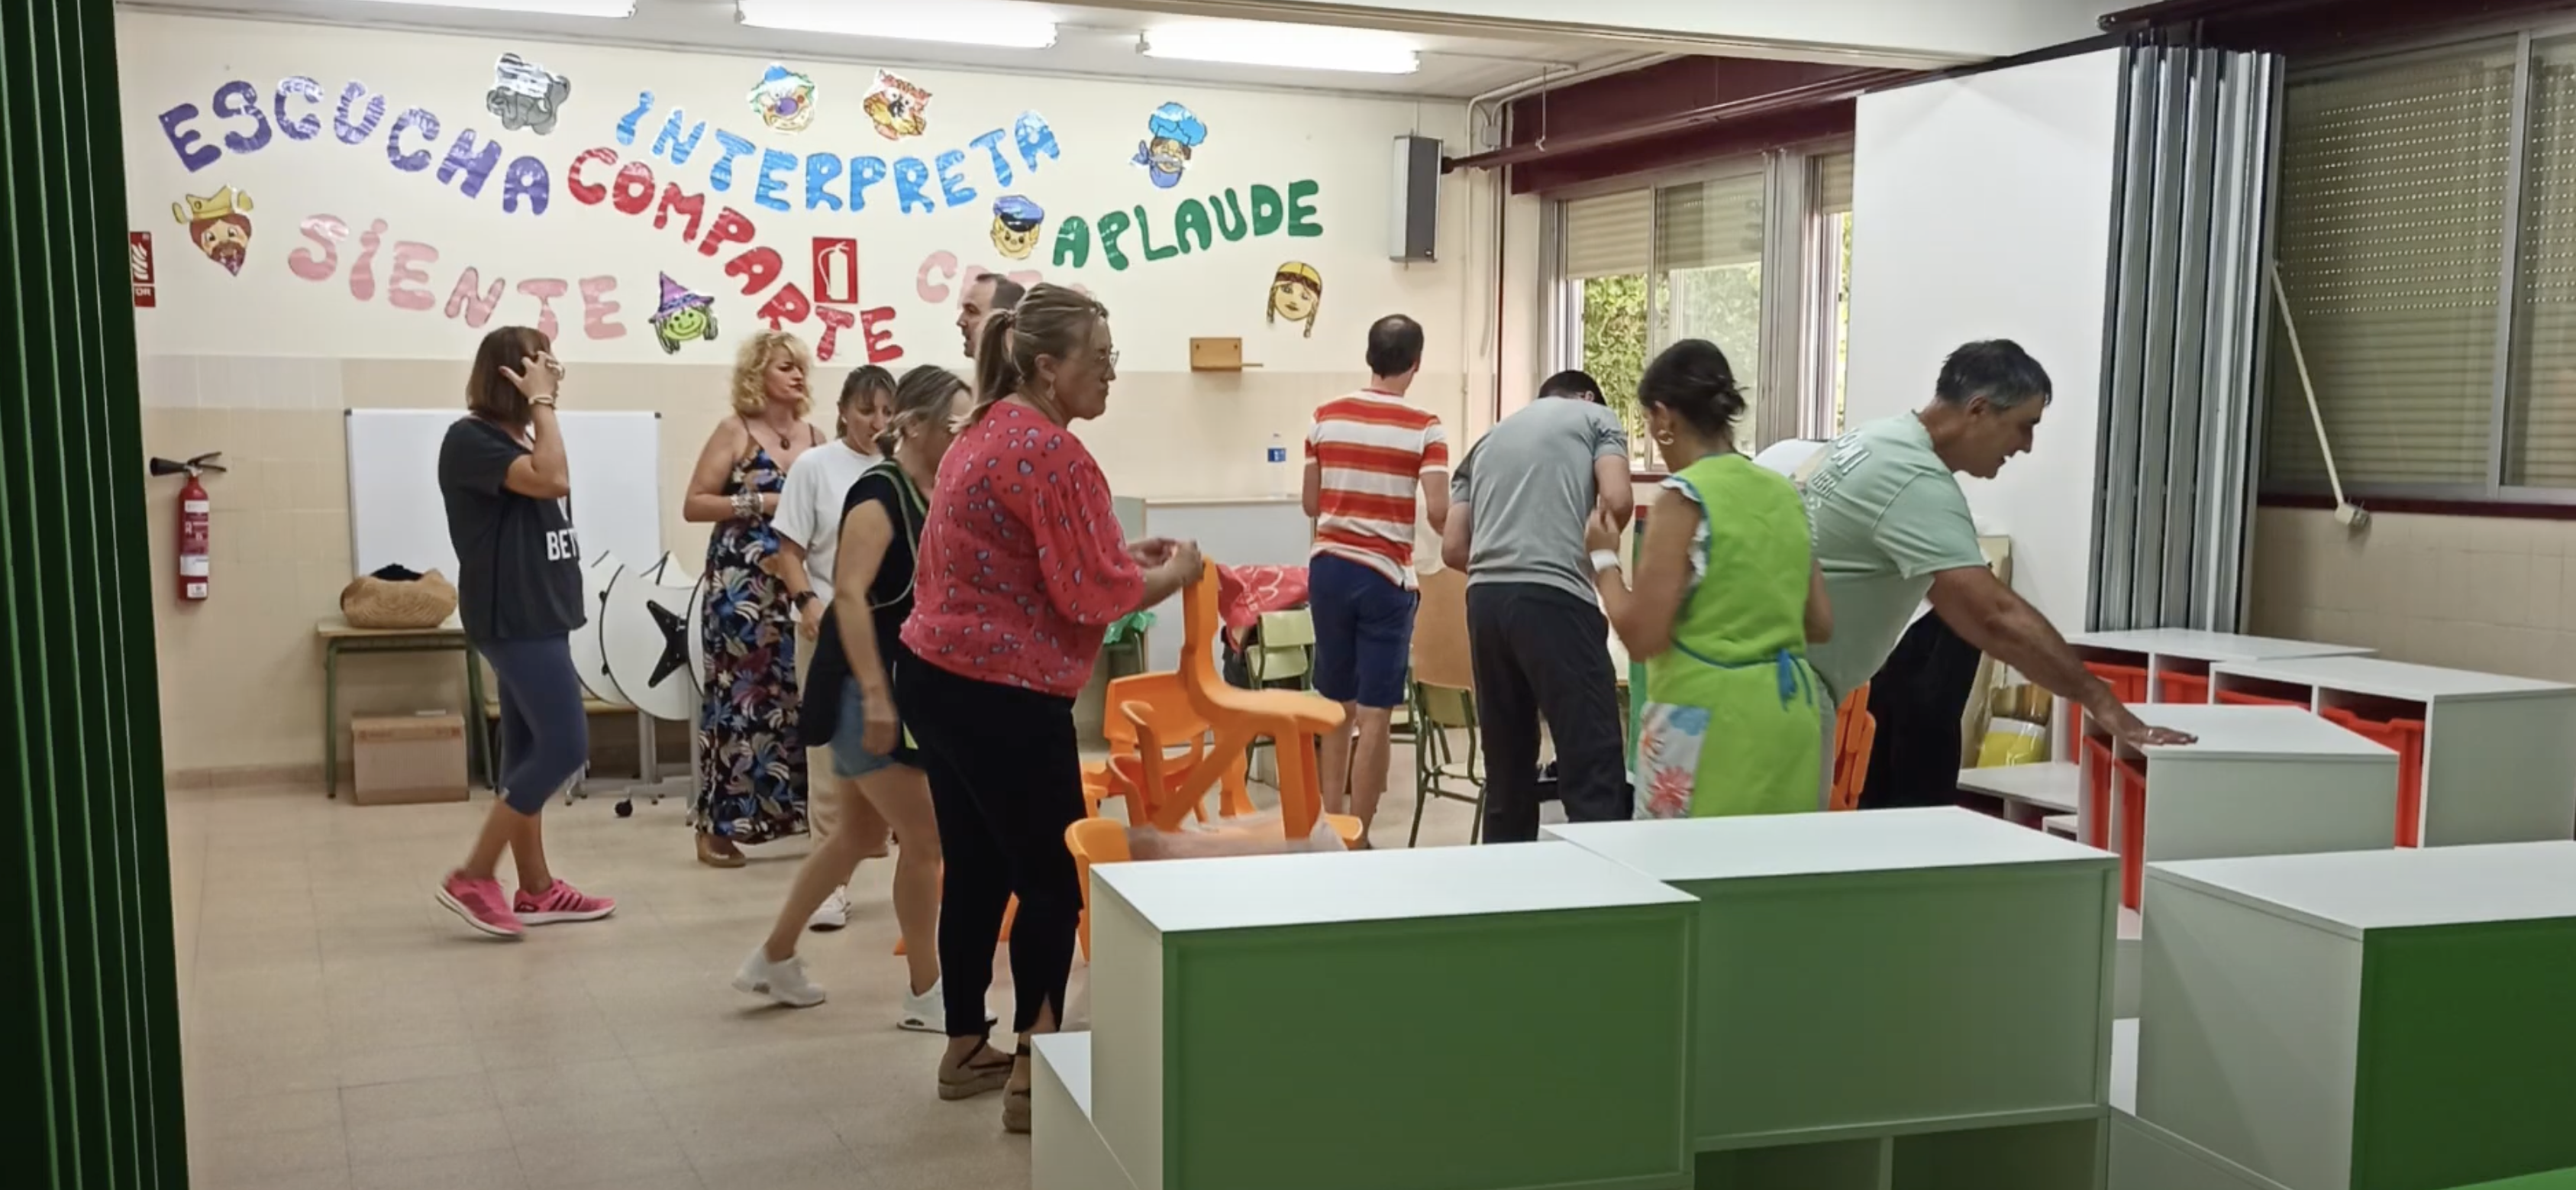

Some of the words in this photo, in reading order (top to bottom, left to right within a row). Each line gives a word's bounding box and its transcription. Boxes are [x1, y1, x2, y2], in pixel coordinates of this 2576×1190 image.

[159, 76, 550, 215] ESCUCHA
[617, 90, 1060, 215] INTERPRETA
[288, 213, 626, 341] SIENTE
[568, 146, 904, 364] COMPARTE
[1053, 179, 1324, 271] APLAUDE
